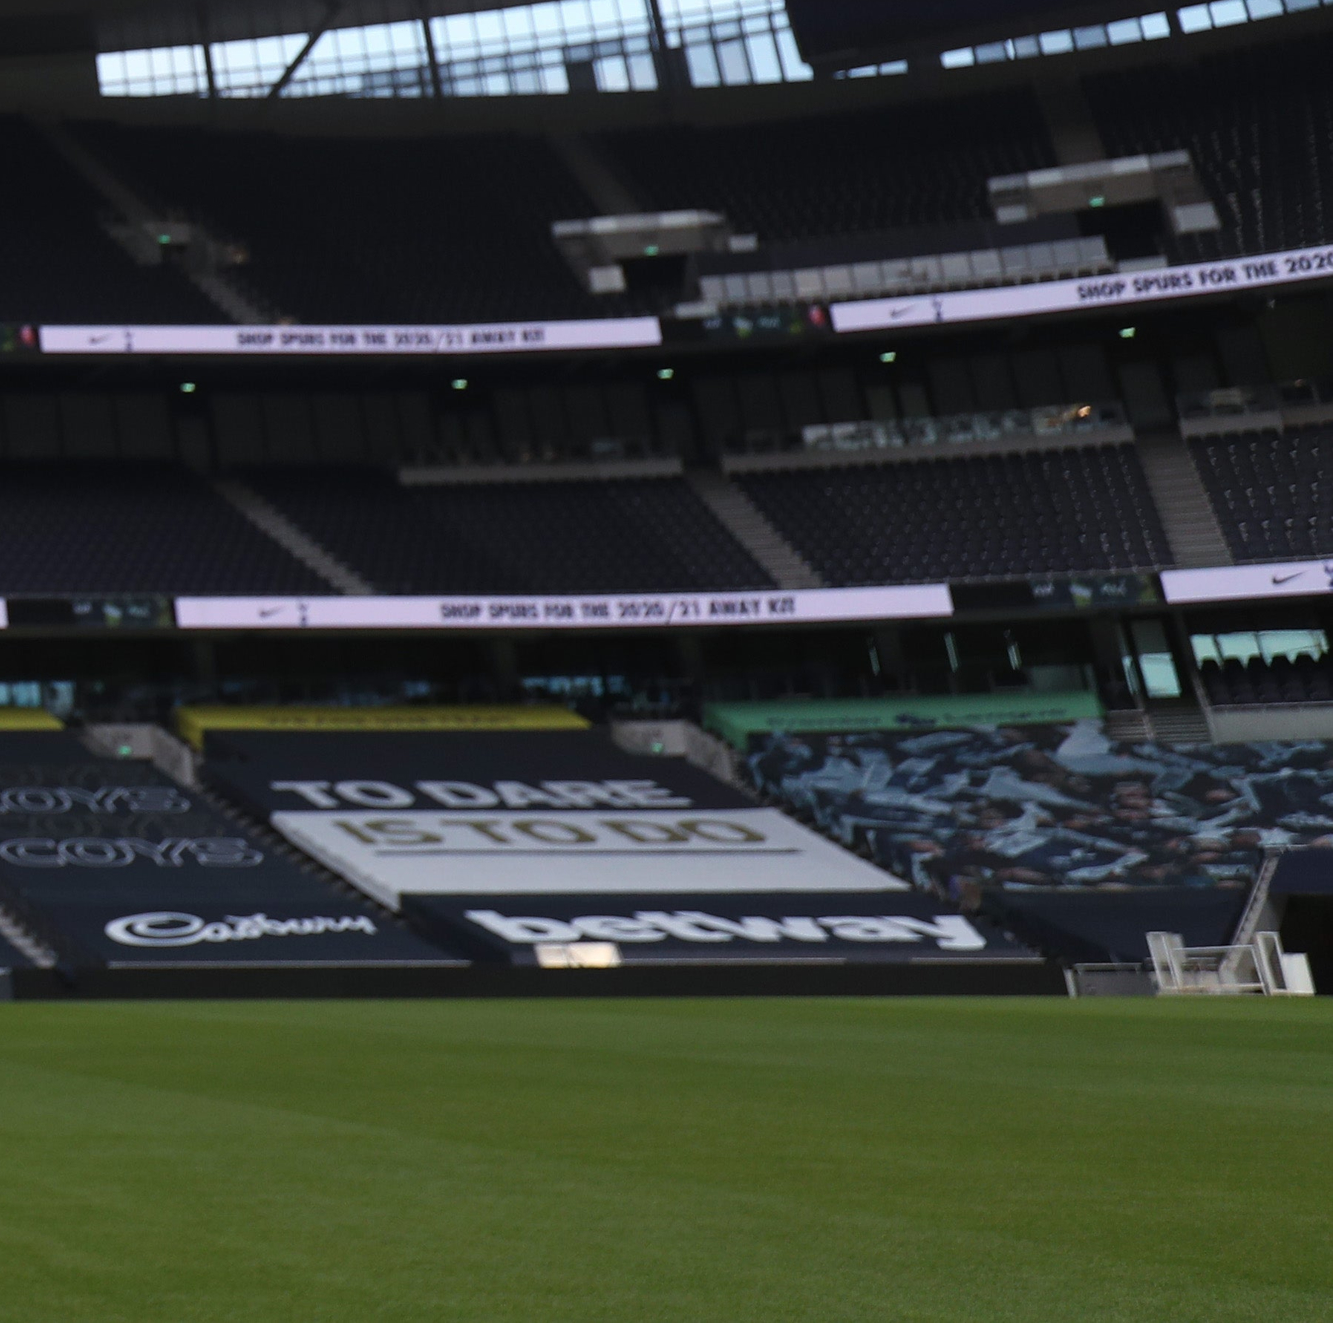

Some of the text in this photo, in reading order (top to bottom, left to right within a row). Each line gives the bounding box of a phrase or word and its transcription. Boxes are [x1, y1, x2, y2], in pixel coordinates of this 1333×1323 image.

[1077, 281, 1126, 299] SHOP
[1132, 273, 1193, 293] SPURS
[1198, 266, 1237, 284] FOR
[1242, 260, 1279, 279] THE
[440, 603, 481, 619] SHOP
[489, 603, 538, 619] SPURS
[544, 603, 573, 618] FOR
[581, 602, 609, 618] THE
[707, 598, 761, 616] AWAY
[767, 596, 797, 614] KIT
[270, 779, 692, 809] TO DARE
[332, 818, 765, 845] IS TO DO
[104, 910, 379, 948] Cadbury
[464, 910, 988, 951] betway
